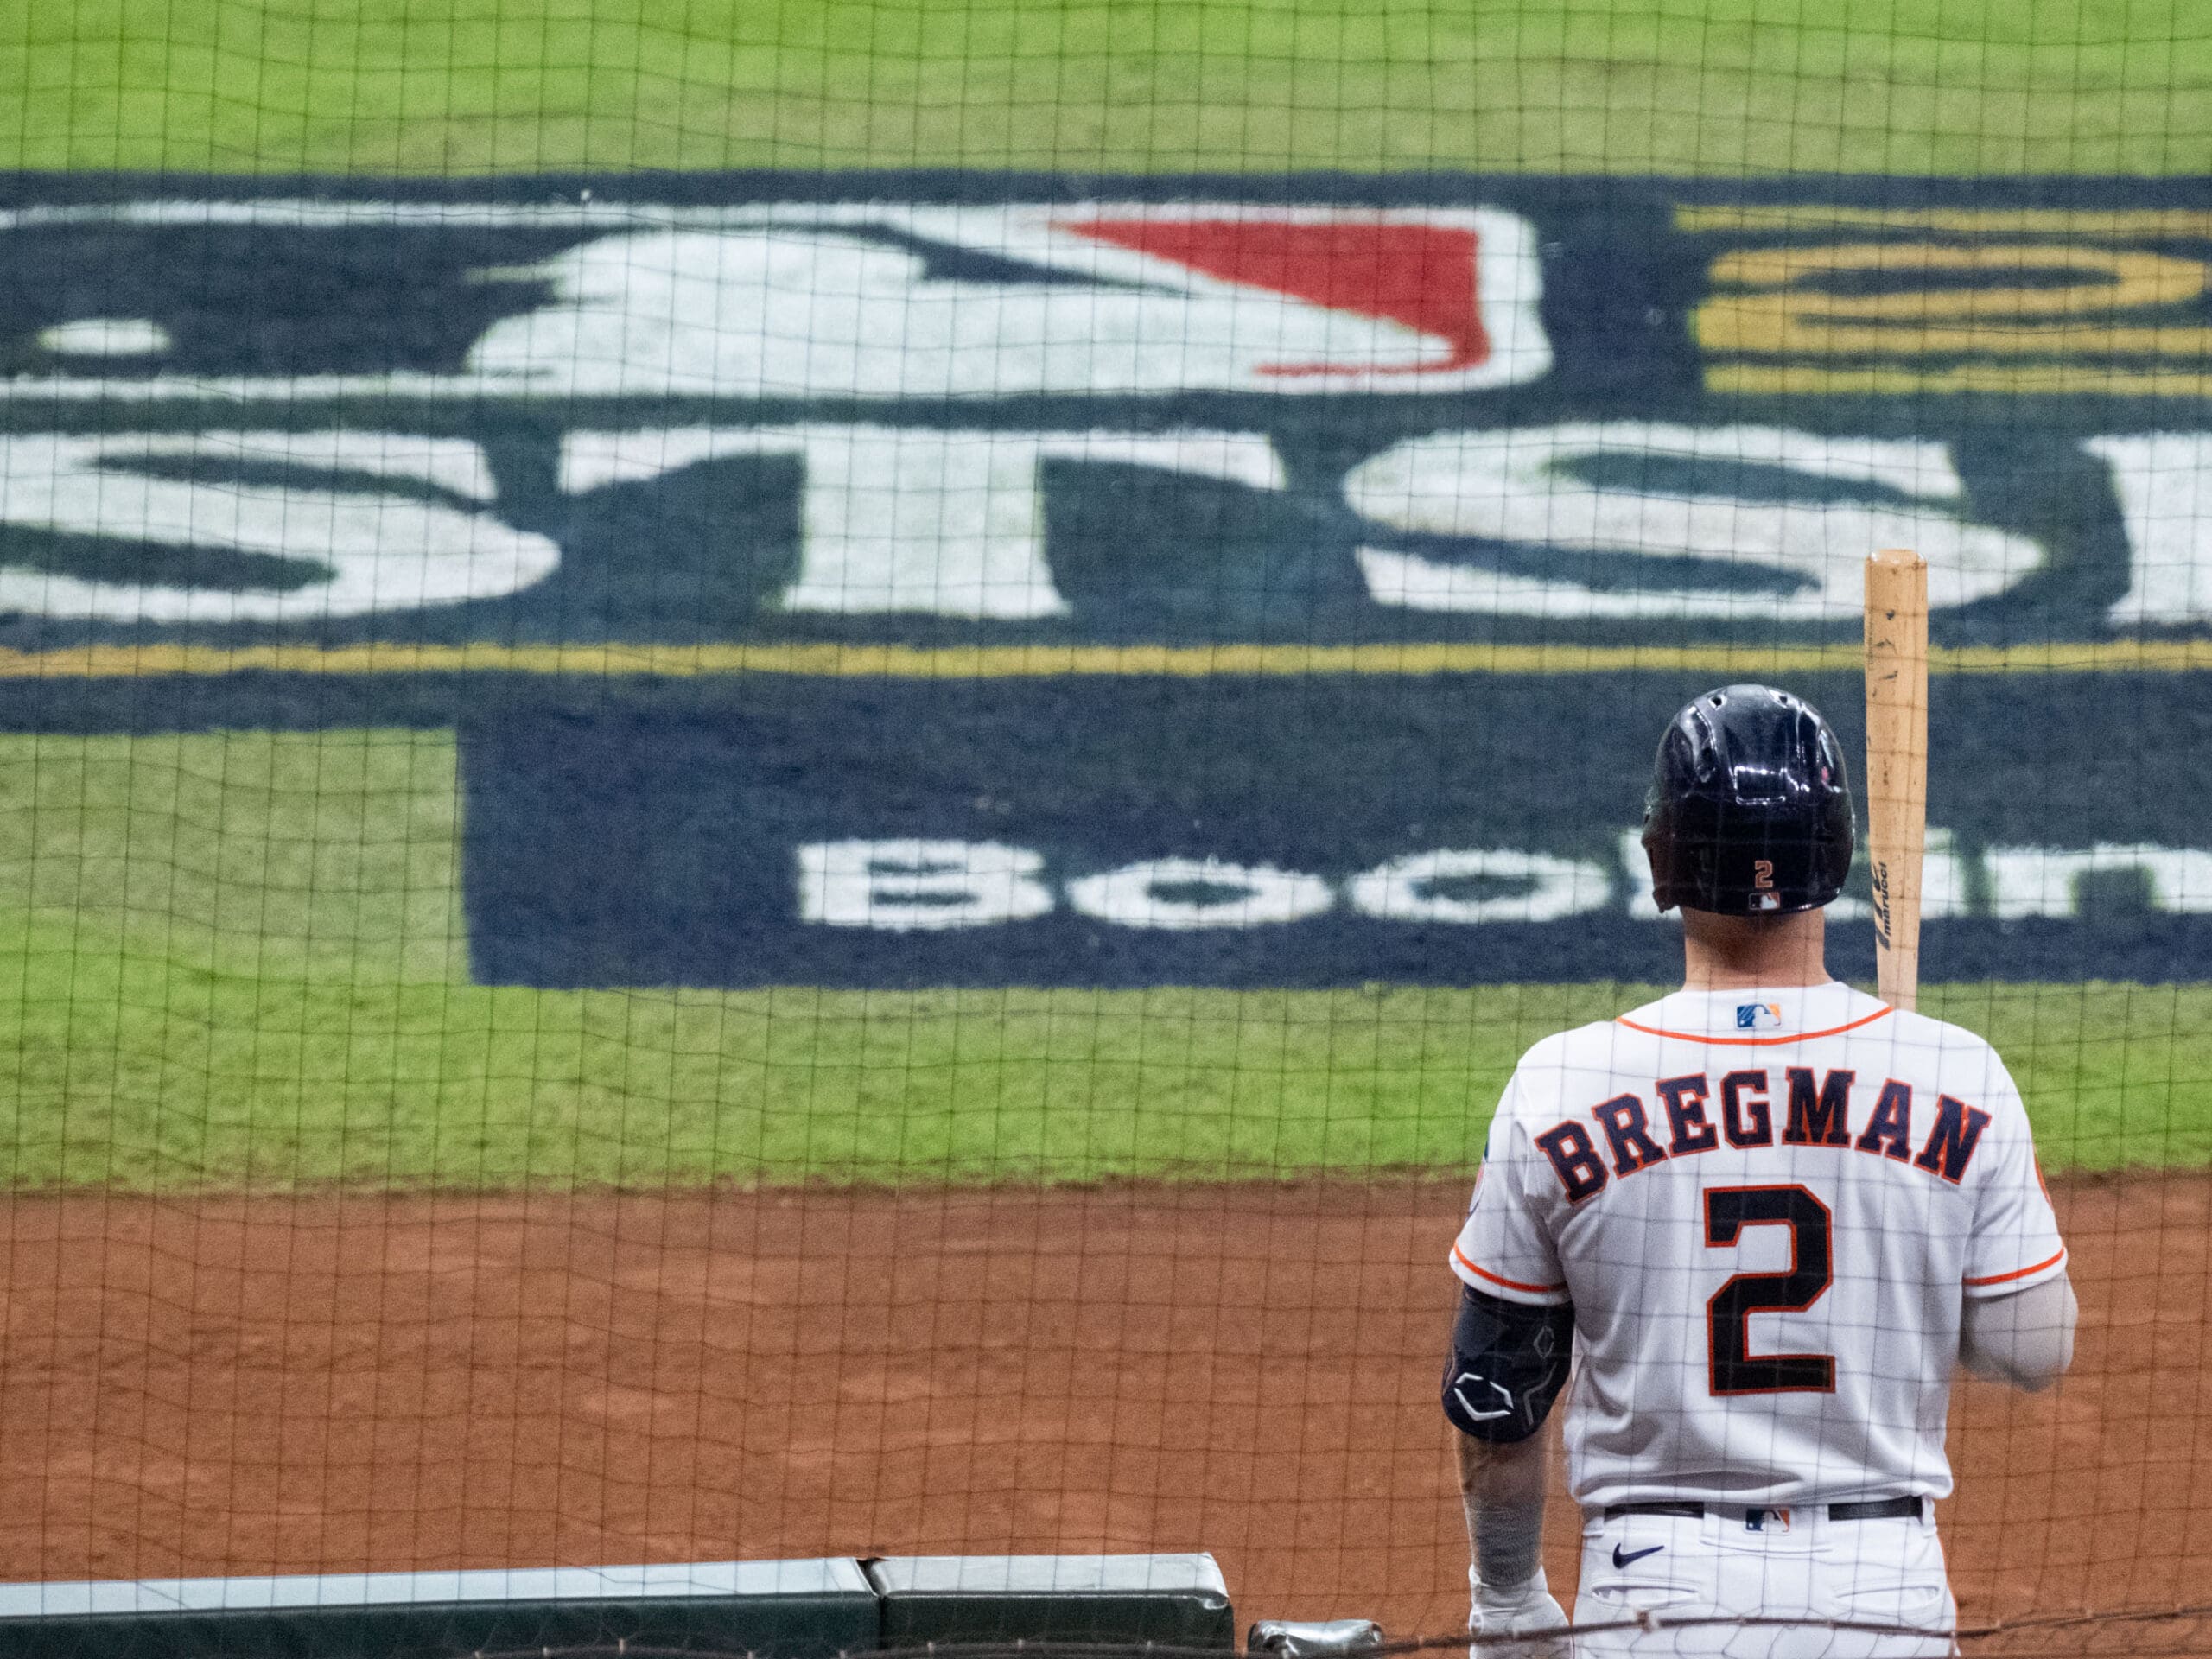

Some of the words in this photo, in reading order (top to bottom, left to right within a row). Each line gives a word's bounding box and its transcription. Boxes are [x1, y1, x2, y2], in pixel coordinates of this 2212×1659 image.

[1754, 860, 1774, 888] 2
[1878, 861, 1892, 938] marucci
[1534, 1066, 1993, 1205] BREGMAN
[1703, 1183, 1836, 1397] 2
